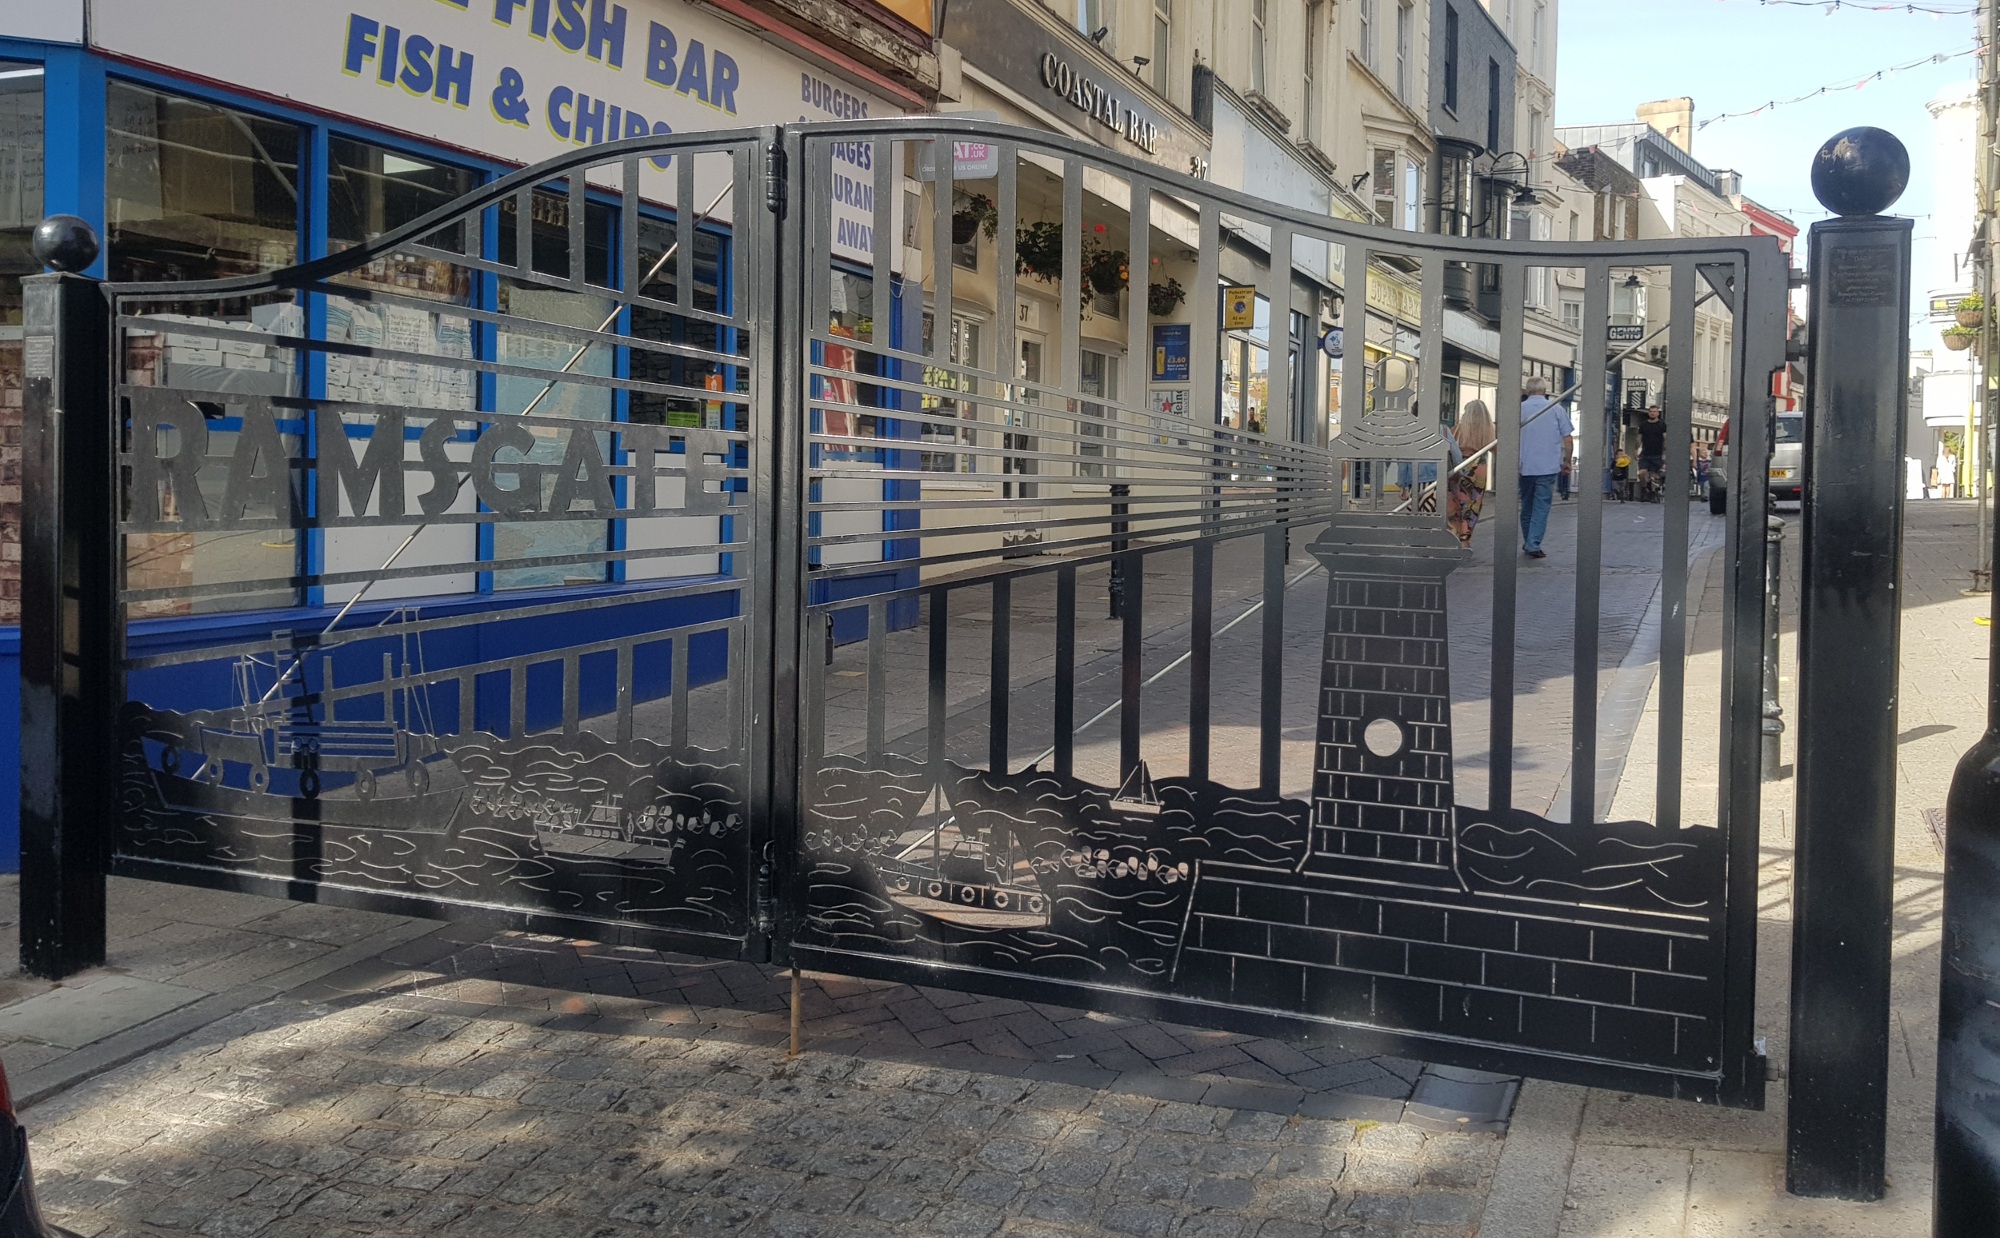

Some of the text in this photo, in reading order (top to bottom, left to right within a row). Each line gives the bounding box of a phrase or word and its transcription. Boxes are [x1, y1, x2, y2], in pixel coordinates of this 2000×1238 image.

[341, 13, 474, 110] FISH
[489, 66, 531, 129] &
[644, 20, 740, 117] BAR
[801, 72, 868, 119] BURGERS
[1042, 52, 1158, 155] COASTAL BAR
[1190, 156, 1208, 181] 37
[1018, 304, 1029, 322] 37
[1609, 327, 1642, 339] GENTS
[131, 387, 731, 522] RAMSGATE
